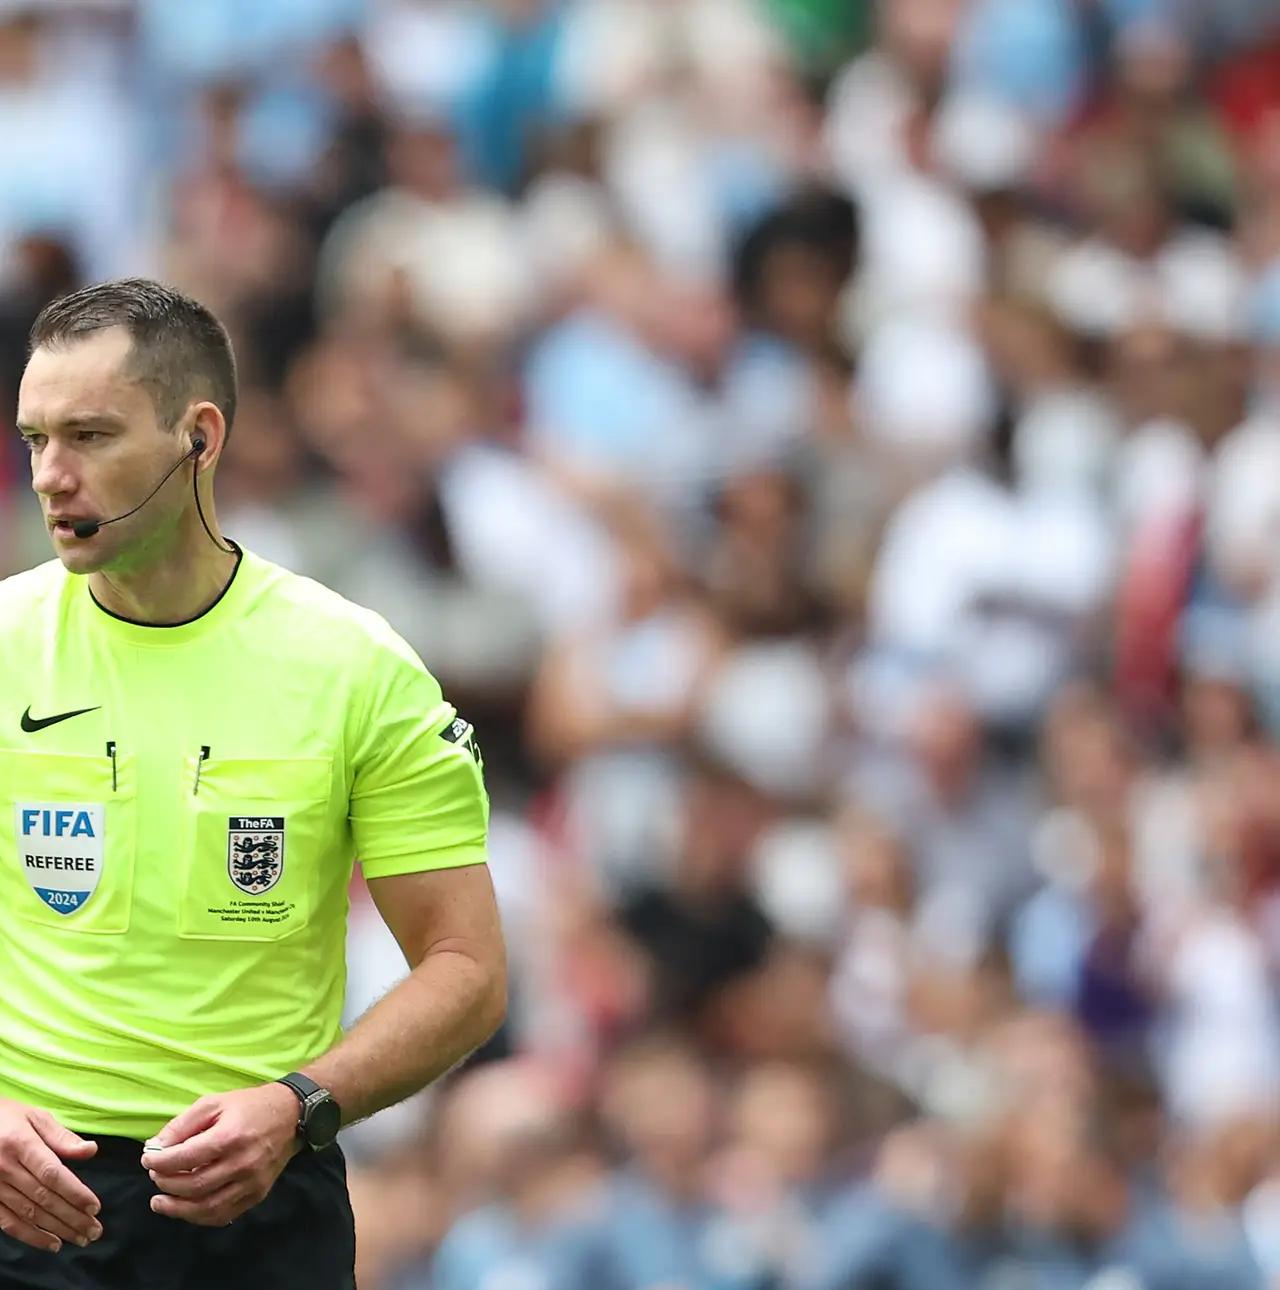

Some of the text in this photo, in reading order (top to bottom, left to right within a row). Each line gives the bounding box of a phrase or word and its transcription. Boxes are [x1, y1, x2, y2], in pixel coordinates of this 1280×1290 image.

[22, 809, 96, 838] FIFA
[25, 854, 95, 871] REFEREE
[47, 892, 79, 906] 2024
